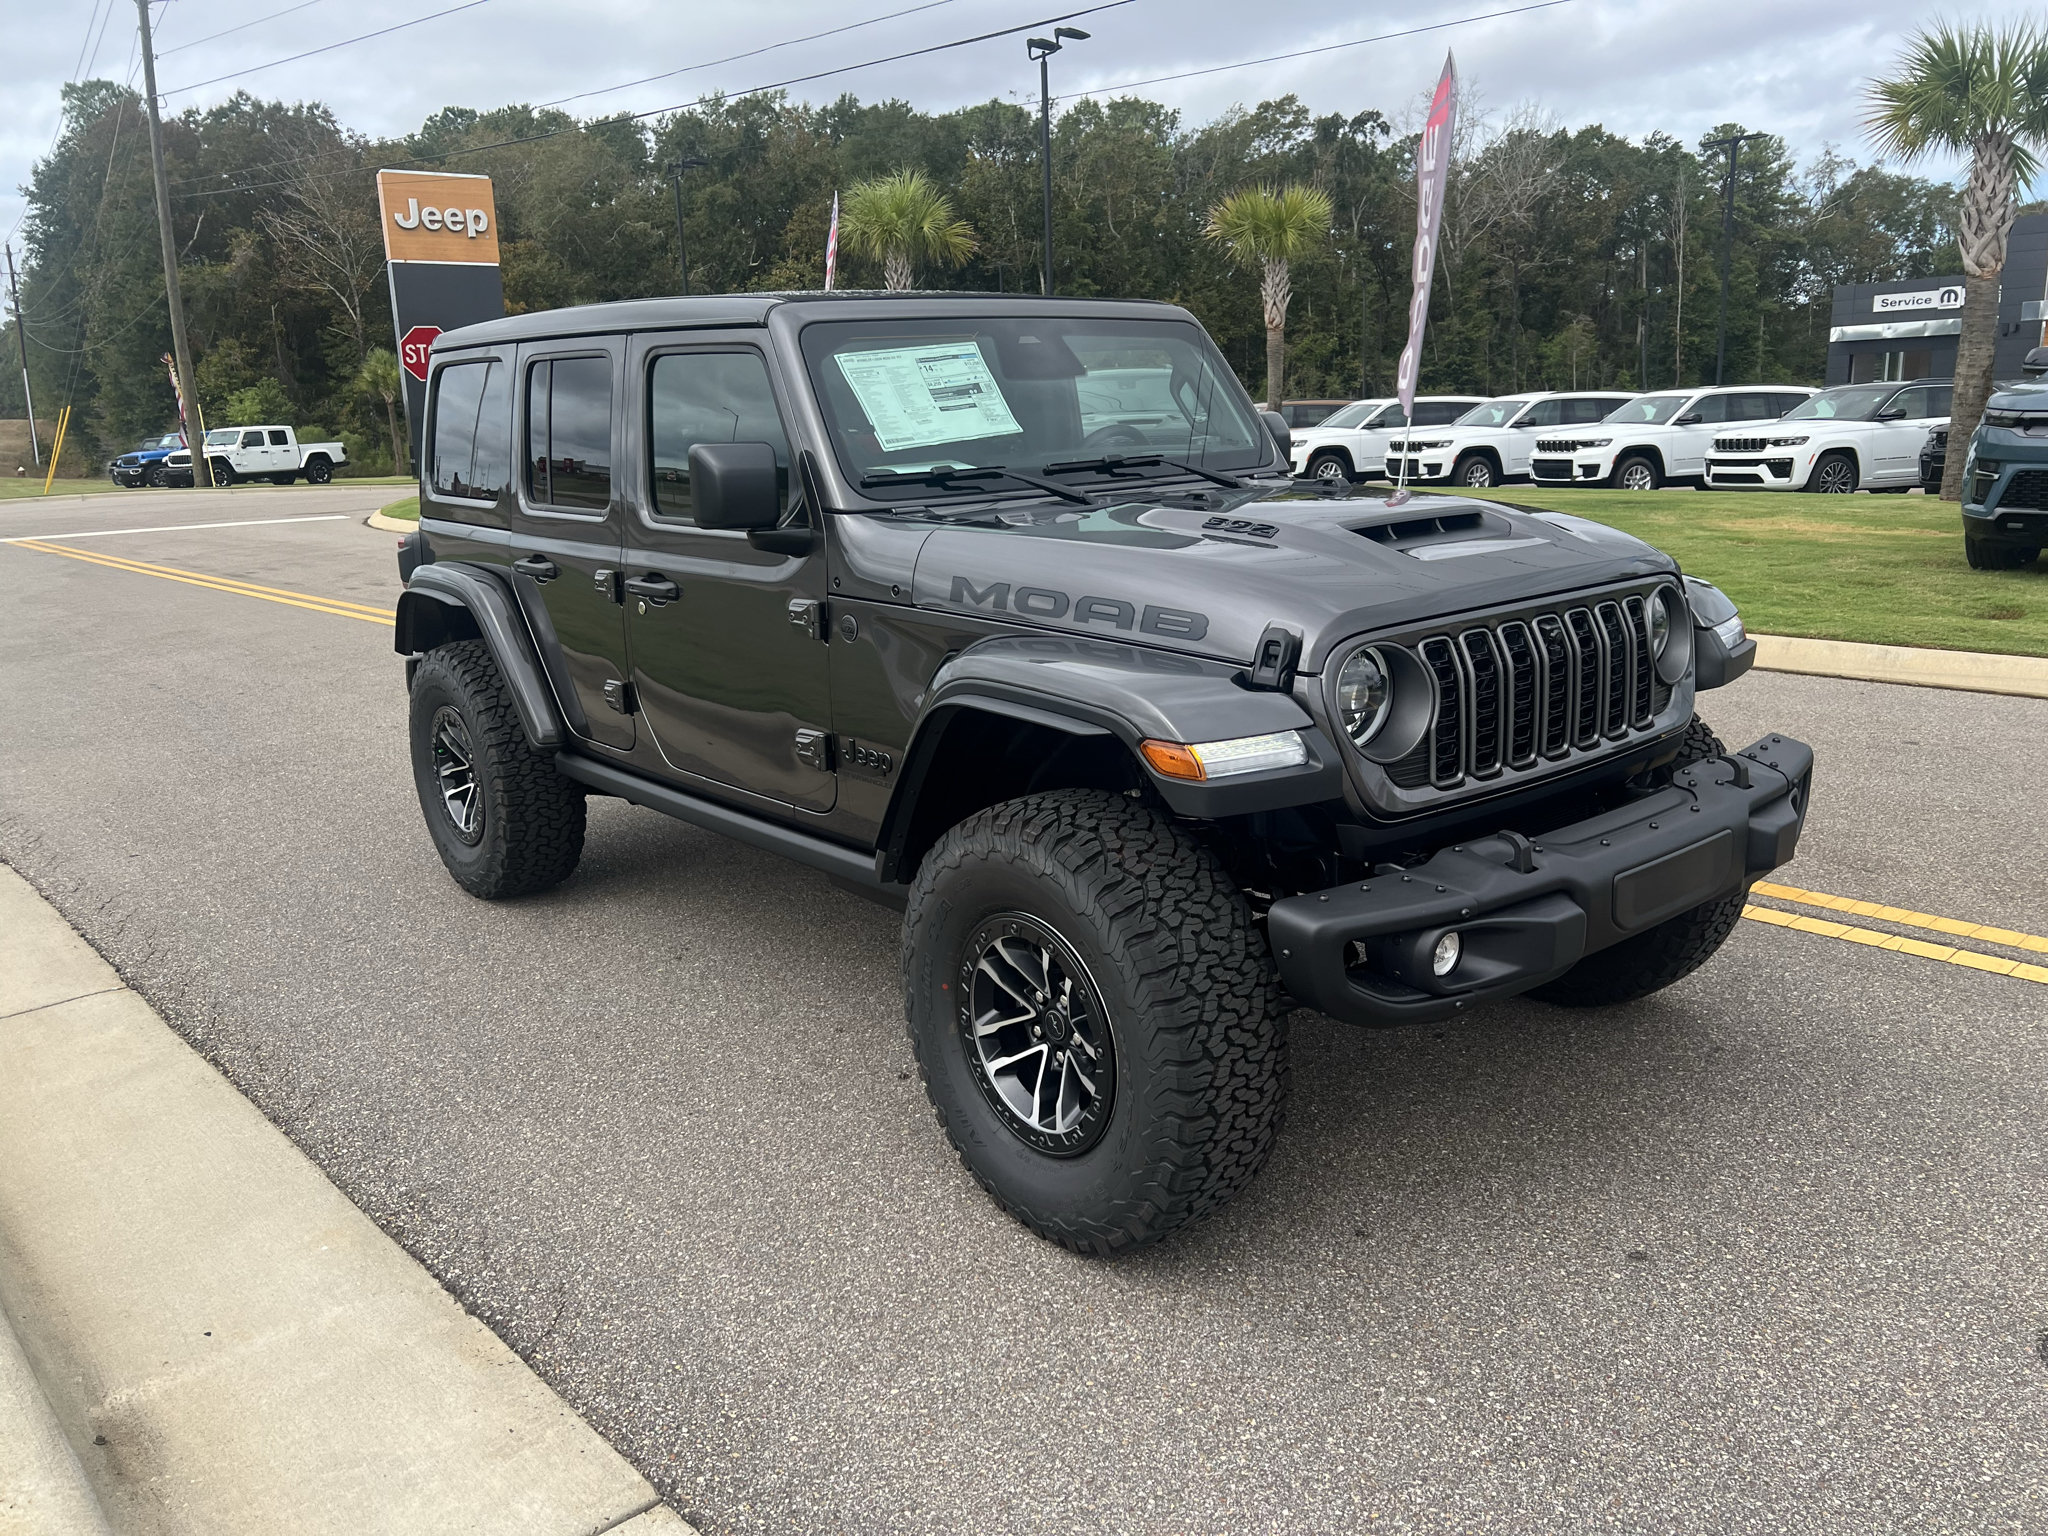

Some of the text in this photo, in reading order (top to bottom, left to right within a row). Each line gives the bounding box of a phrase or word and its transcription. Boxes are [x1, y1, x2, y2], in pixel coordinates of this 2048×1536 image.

[394, 197, 489, 238] Jeep
[1398, 124, 1440, 390] DODGE
[1880, 296, 1932, 308] Service
[405, 343, 432, 364] ST
[1201, 516, 1280, 539] 392
[949, 575, 1210, 642] MOAB
[841, 737, 893, 777] Jeep
